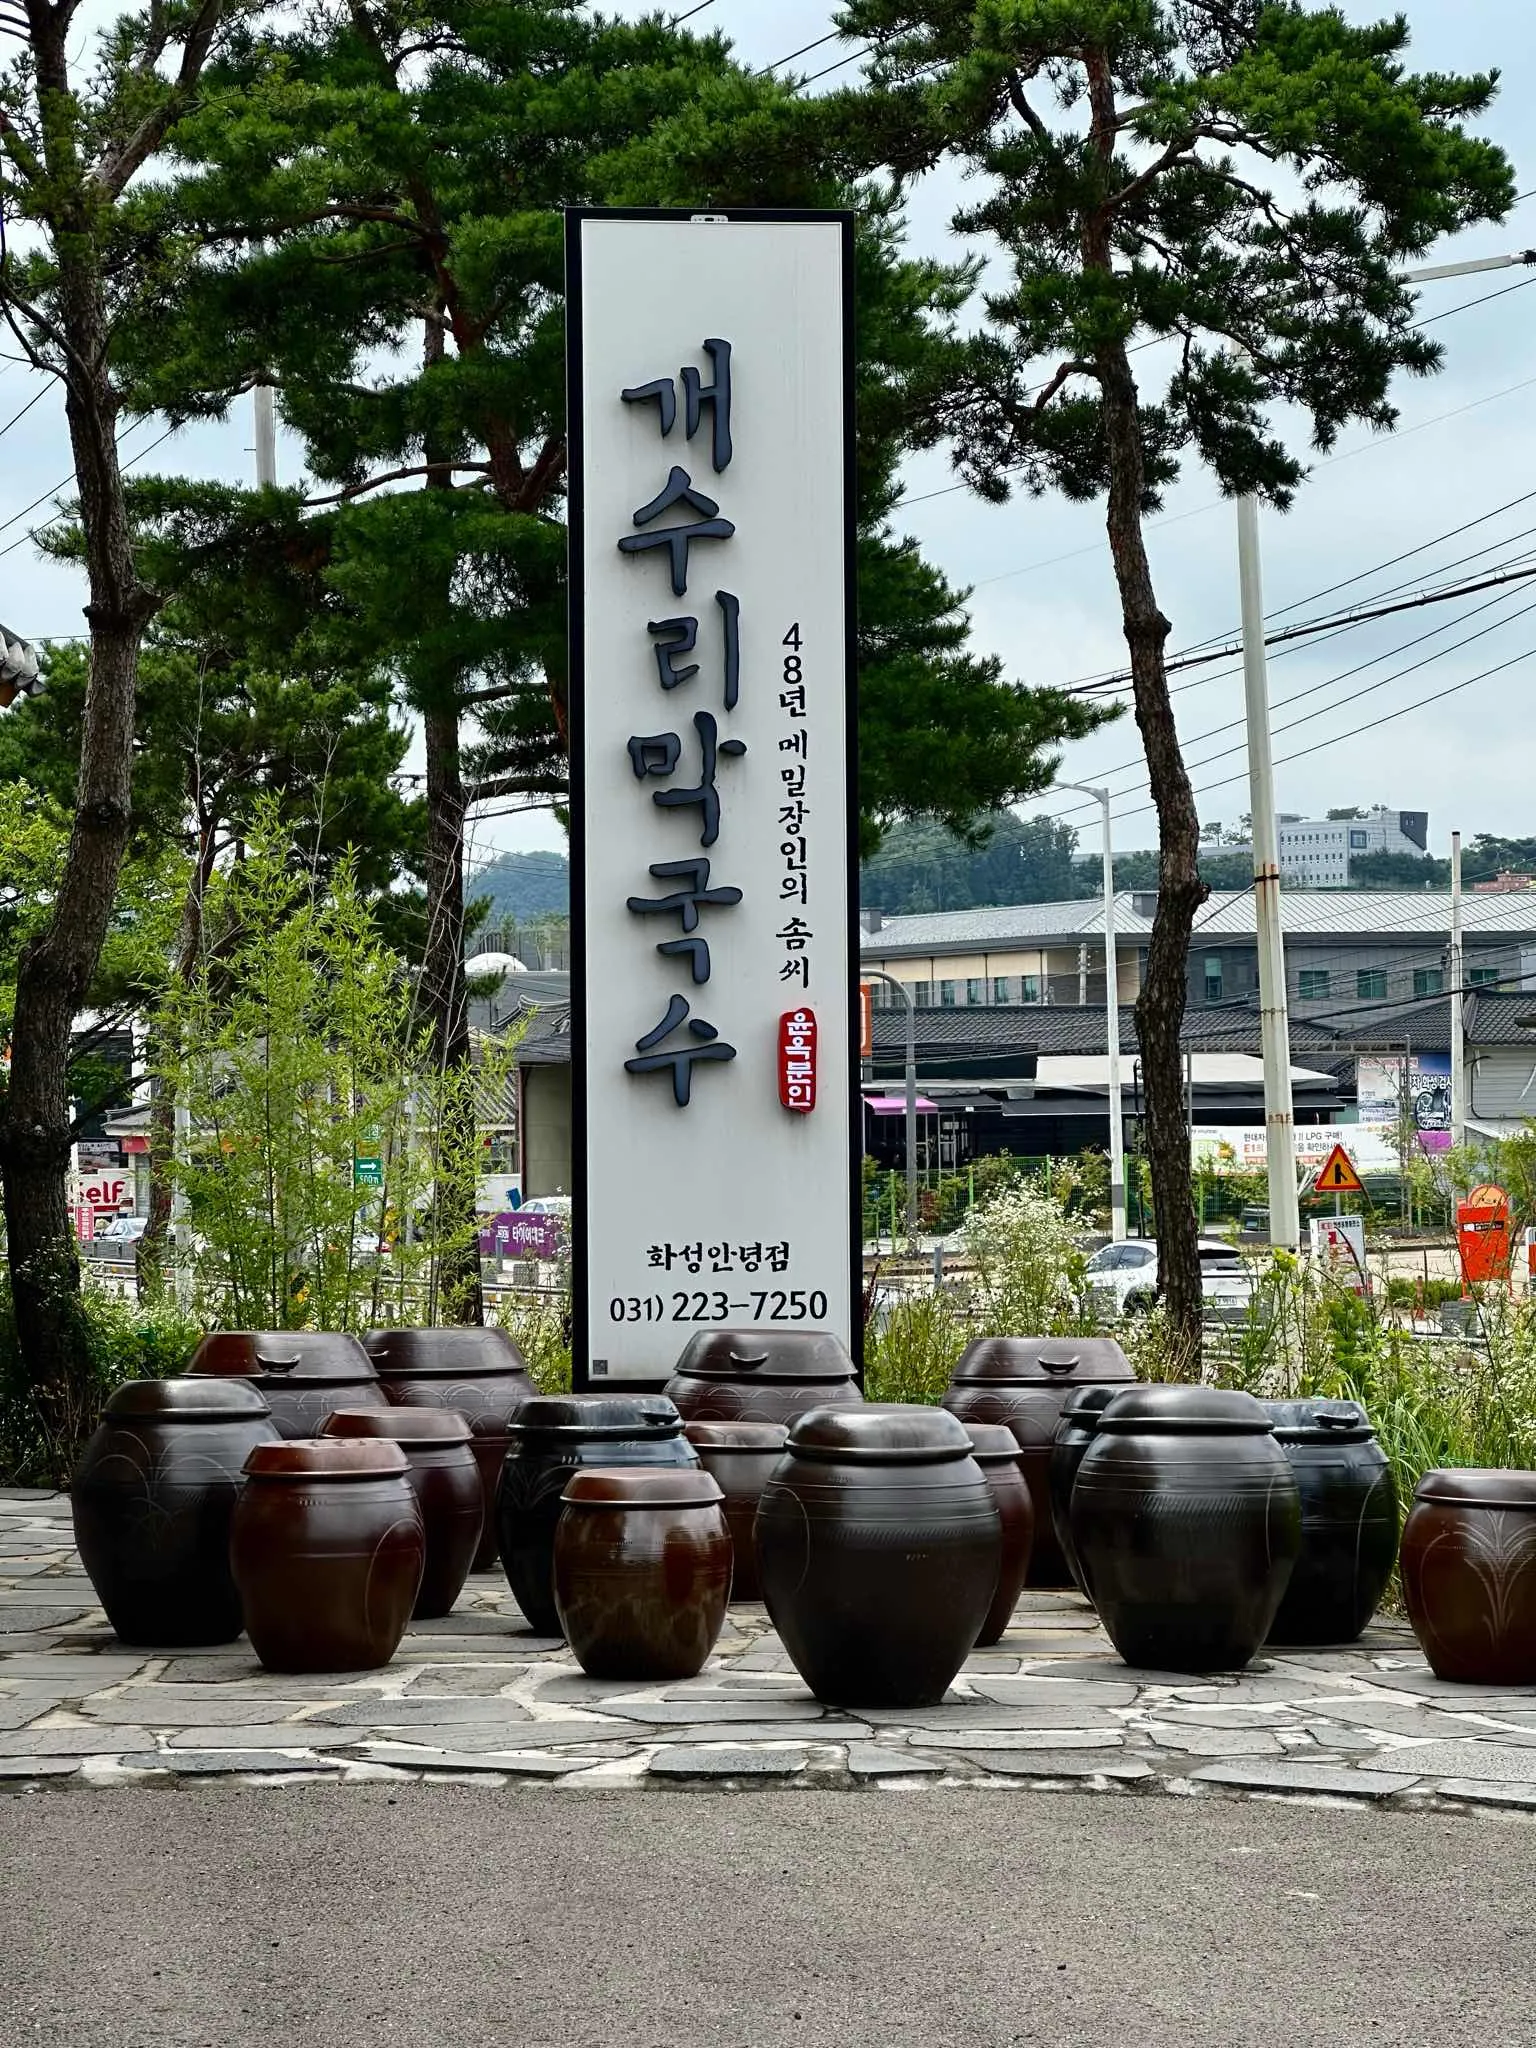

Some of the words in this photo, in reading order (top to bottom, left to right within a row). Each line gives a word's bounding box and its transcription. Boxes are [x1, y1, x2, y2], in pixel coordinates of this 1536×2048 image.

[779, 622, 806, 717] 48년
[618, 338, 747, 1107] 개수리막국수
[778, 729, 810, 904] 메밀장인의
[776, 917, 813, 988] 솜씨
[1306, 1132, 1322, 1140] LPG
[360, 1174, 379, 1185] 500m
[609, 1294, 664, 1322] 031)
[672, 1290, 828, 1322] 223-7250
